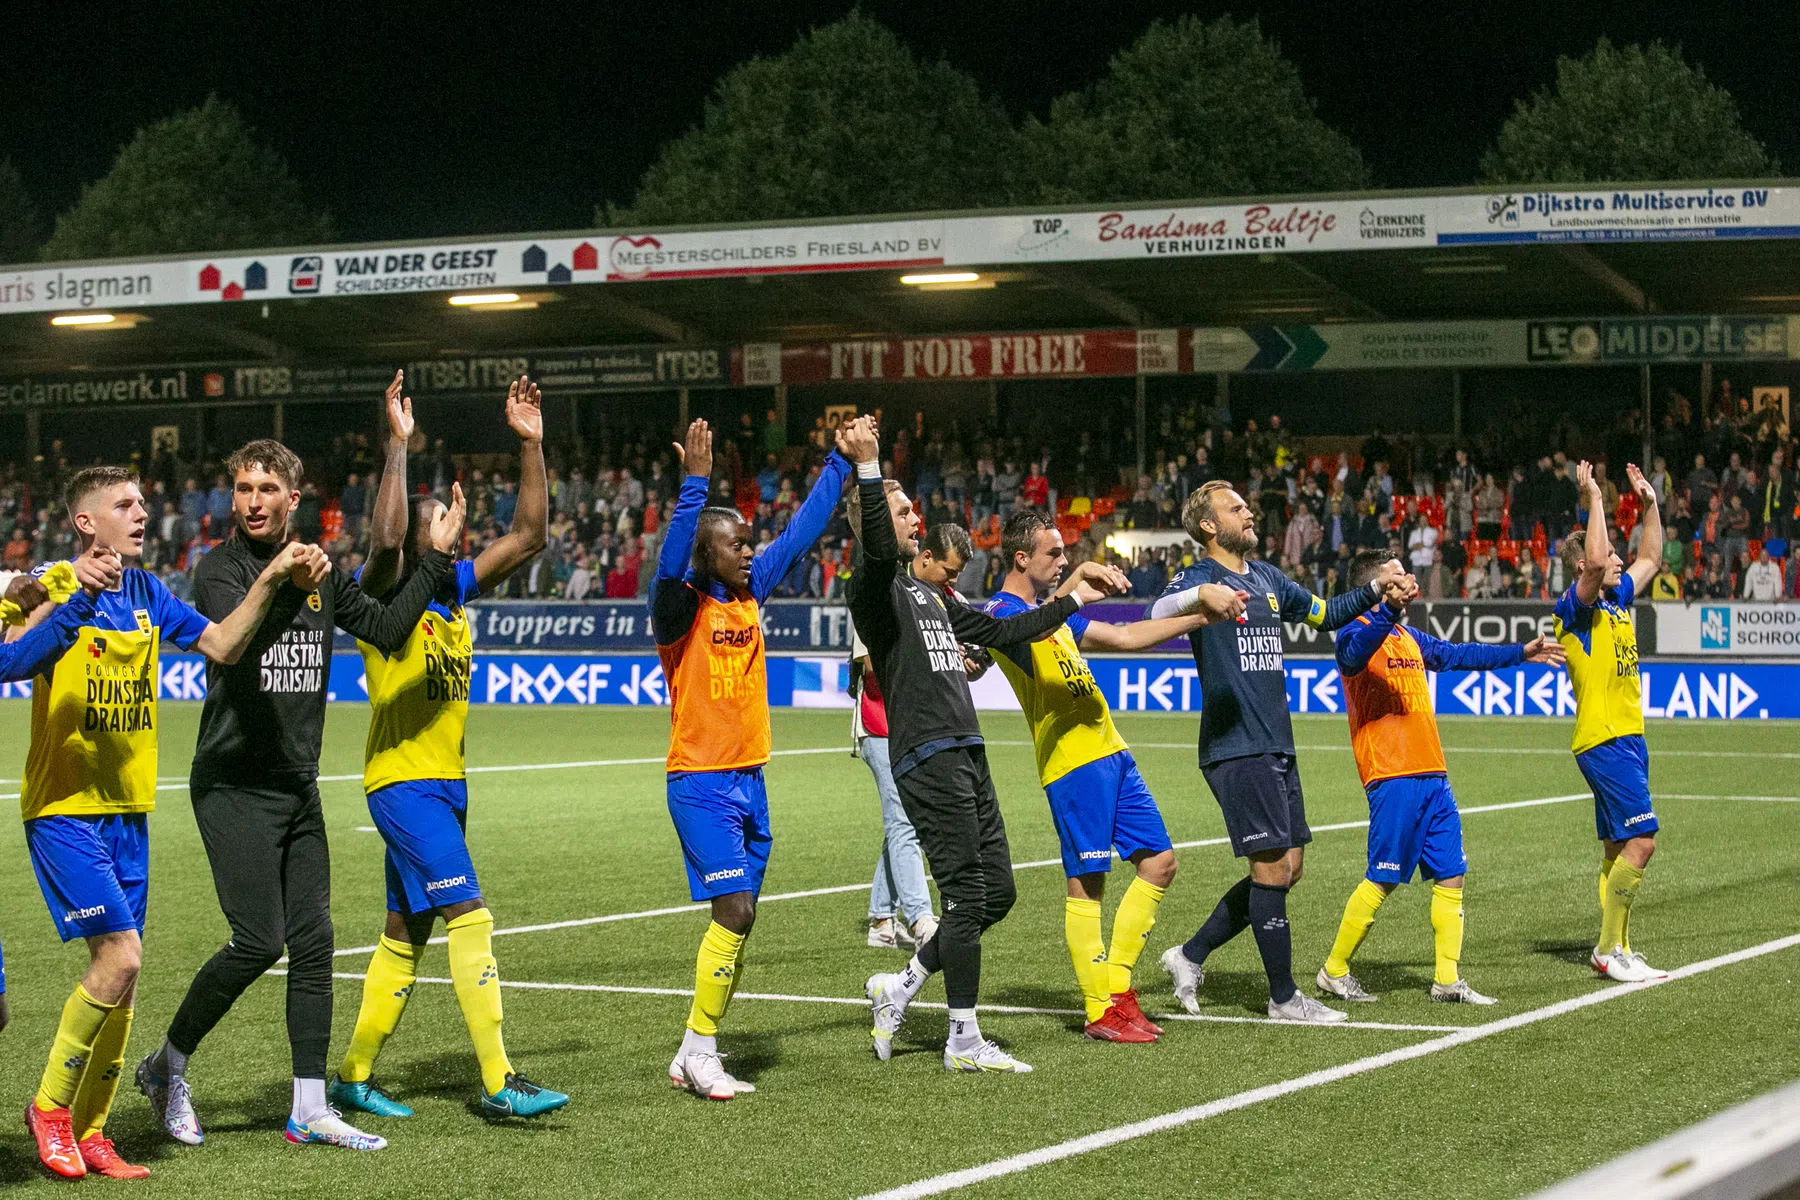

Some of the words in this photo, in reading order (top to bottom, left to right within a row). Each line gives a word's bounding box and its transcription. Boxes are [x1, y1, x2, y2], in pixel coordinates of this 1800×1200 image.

[1523, 192, 1605, 217] Dijkstra
[1612, 188, 1734, 211] Multiservice
[1742, 190, 1768, 206] BV
[1033, 218, 1062, 233] TOP
[1099, 213, 1228, 241] Bandsma
[1245, 204, 1337, 243] Bultje
[1360, 226, 1426, 238] VERHUIZERS
[1377, 214, 1426, 226] ERKENDE
[1549, 215, 1675, 227] Landbouwmechanisatie
[1694, 212, 1741, 224] Industrie
[917, 238, 942, 251] BV
[1145, 236, 1286, 253] VERHUIZINGEN
[335, 257, 380, 275] VAN
[384, 254, 425, 272] DER
[432, 249, 498, 270] GEEST
[0, 277, 35, 303] ris
[45, 273, 152, 306] slagman
[335, 273, 497, 293] SCHILDERSPECIALISTEN
[1531, 326, 1599, 354] LEO
[655, 350, 719, 380] ITBB
[830, 342, 888, 380] FIT
[903, 338, 976, 377] FOR
[990, 334, 1085, 374] FREE
[488, 611, 595, 642] toppers
[606, 608, 639, 636] in
[1387, 658, 1419, 669] CRAFT
[260, 668, 322, 692] DRAISMA
[427, 679, 468, 701] DRAIS
[486, 662, 611, 703] PROEF
[1119, 667, 1199, 711] HET
